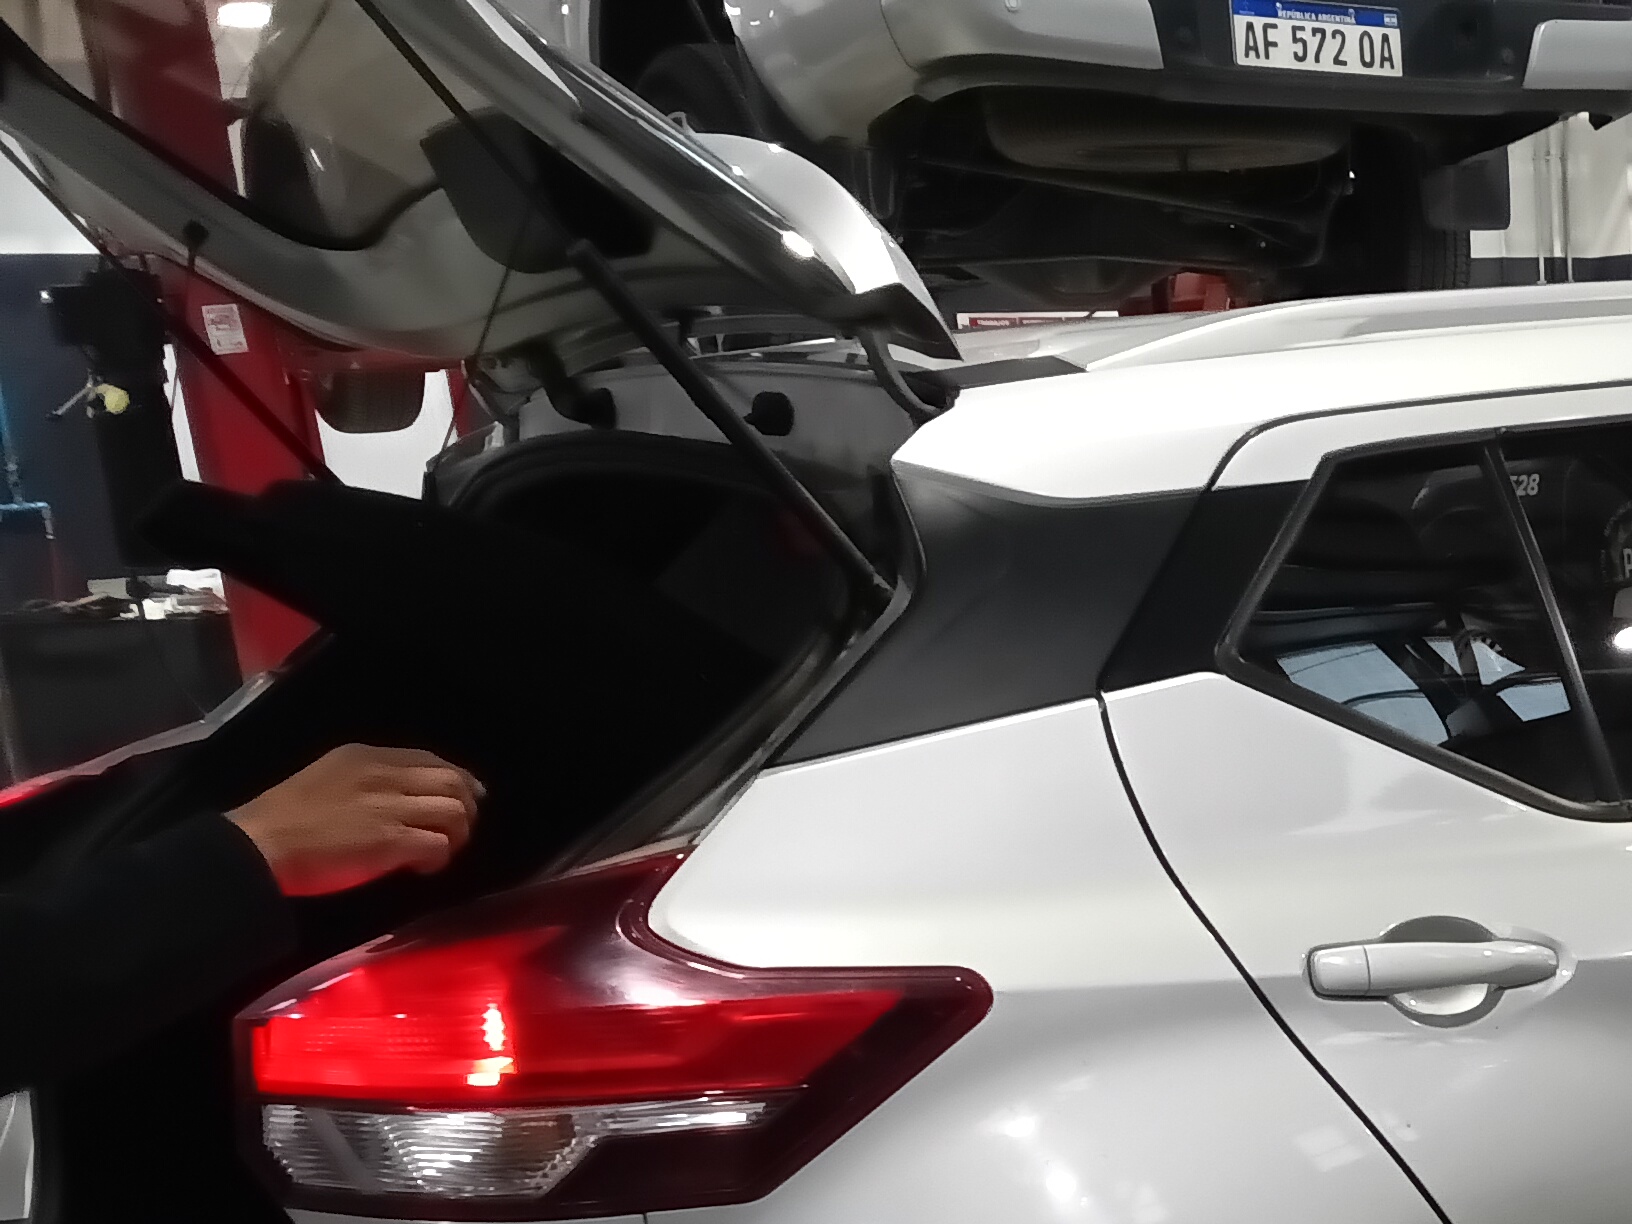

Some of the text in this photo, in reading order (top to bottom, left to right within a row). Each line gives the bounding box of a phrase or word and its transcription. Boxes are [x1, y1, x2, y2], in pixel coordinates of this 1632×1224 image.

[1318, 14, 1356, 24] ARGENTINA
[1244, 21, 1278, 60] AF
[1291, 25, 1348, 66] 572
